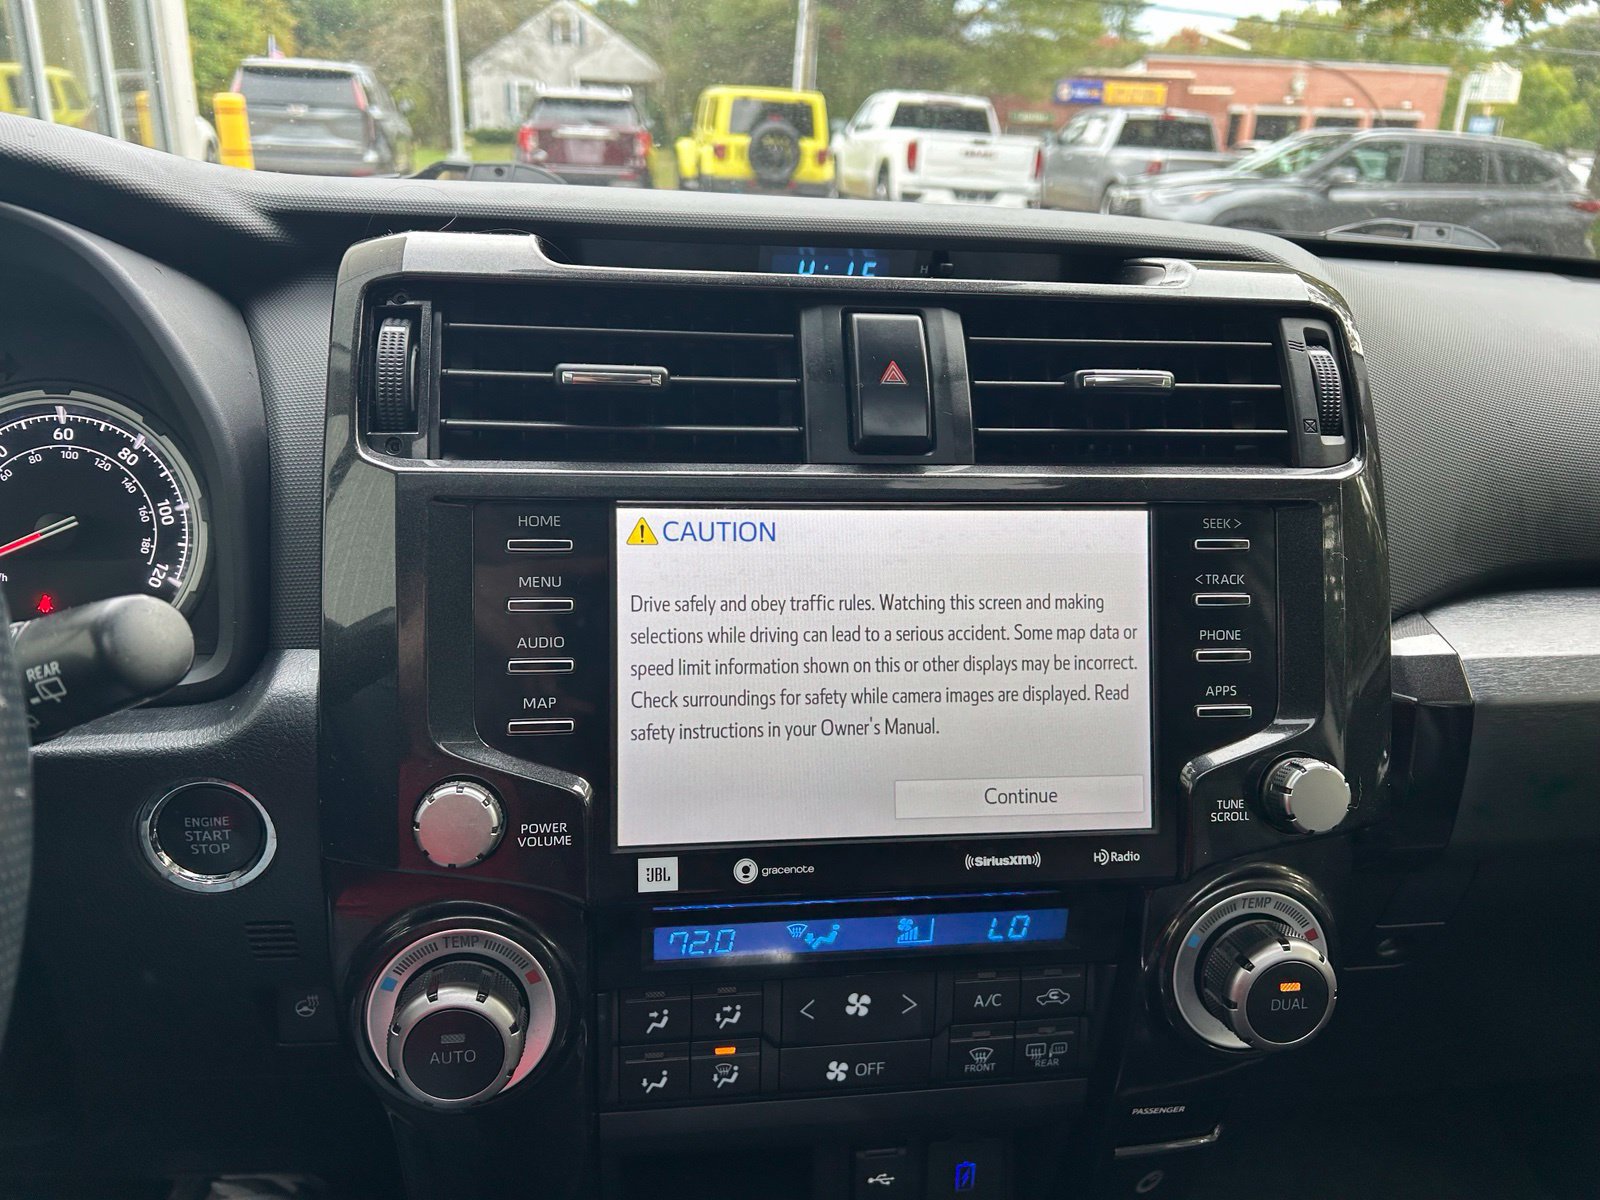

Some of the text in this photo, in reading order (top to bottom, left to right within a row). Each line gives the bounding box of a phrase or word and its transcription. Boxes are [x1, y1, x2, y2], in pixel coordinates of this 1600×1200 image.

[54, 428, 73, 440] 60
[28, 453, 42, 464] 80
[60, 450, 79, 461] 100
[118, 447, 139, 466] 80
[94, 457, 112, 472] 120
[121, 477, 137, 495] 140
[138, 505, 150, 523] 160
[157, 498, 174, 526] 100
[519, 516, 560, 526] HOME
[1203, 518, 1230, 528] SEEK
[663, 521, 775, 542] CAUTION
[140, 537, 151, 554] 180
[148, 563, 169, 588] 120
[1206, 574, 1244, 584] TRACK
[519, 577, 561, 587] MENU
[632, 593, 1104, 615] Drive safely and obey traffic rules. Watching this screen and making
[631, 623, 1137, 646] selections while driving can lead to a serious accident. Some map data or
[1200, 630, 1241, 640] PHONE
[517, 637, 564, 648] AUDIO
[26, 661, 61, 682] REAR
[631, 654, 1137, 680] speed limit information shown on this or other displays may be incorrect.
[632, 684, 1128, 709] Check surroundings for safety while camera images are displayed. Read
[1206, 686, 1236, 696] APPS
[524, 698, 556, 709] MAP
[631, 717, 939, 744] safety instructions in your Owner's Manual.
[985, 788, 1057, 804] Continue
[1217, 800, 1244, 809] TUNE
[185, 816, 229, 827] ENGINE
[1211, 812, 1249, 822] SCROLL
[521, 823, 567, 833] POWER
[185, 830, 231, 841] START
[518, 836, 571, 847] VOLUME
[191, 843, 230, 854] STOP
[1111, 852, 1140, 861] Radio
[647, 867, 670, 882] JBL
[762, 865, 814, 876] gracenote
[1241, 897, 1272, 909] TEMP
[442, 935, 480, 949] TEMP
[669, 929, 736, 955] 72.0
[974, 994, 1001, 1007] A/C
[1271, 998, 1308, 1010] DUAL
[430, 1050, 475, 1064] AUTO
[1035, 1058, 1059, 1067] REAR
[856, 1062, 885, 1076] OFF
[964, 1063, 995, 1072] FRONT
[1132, 1106, 1185, 1114] PASSENGER
